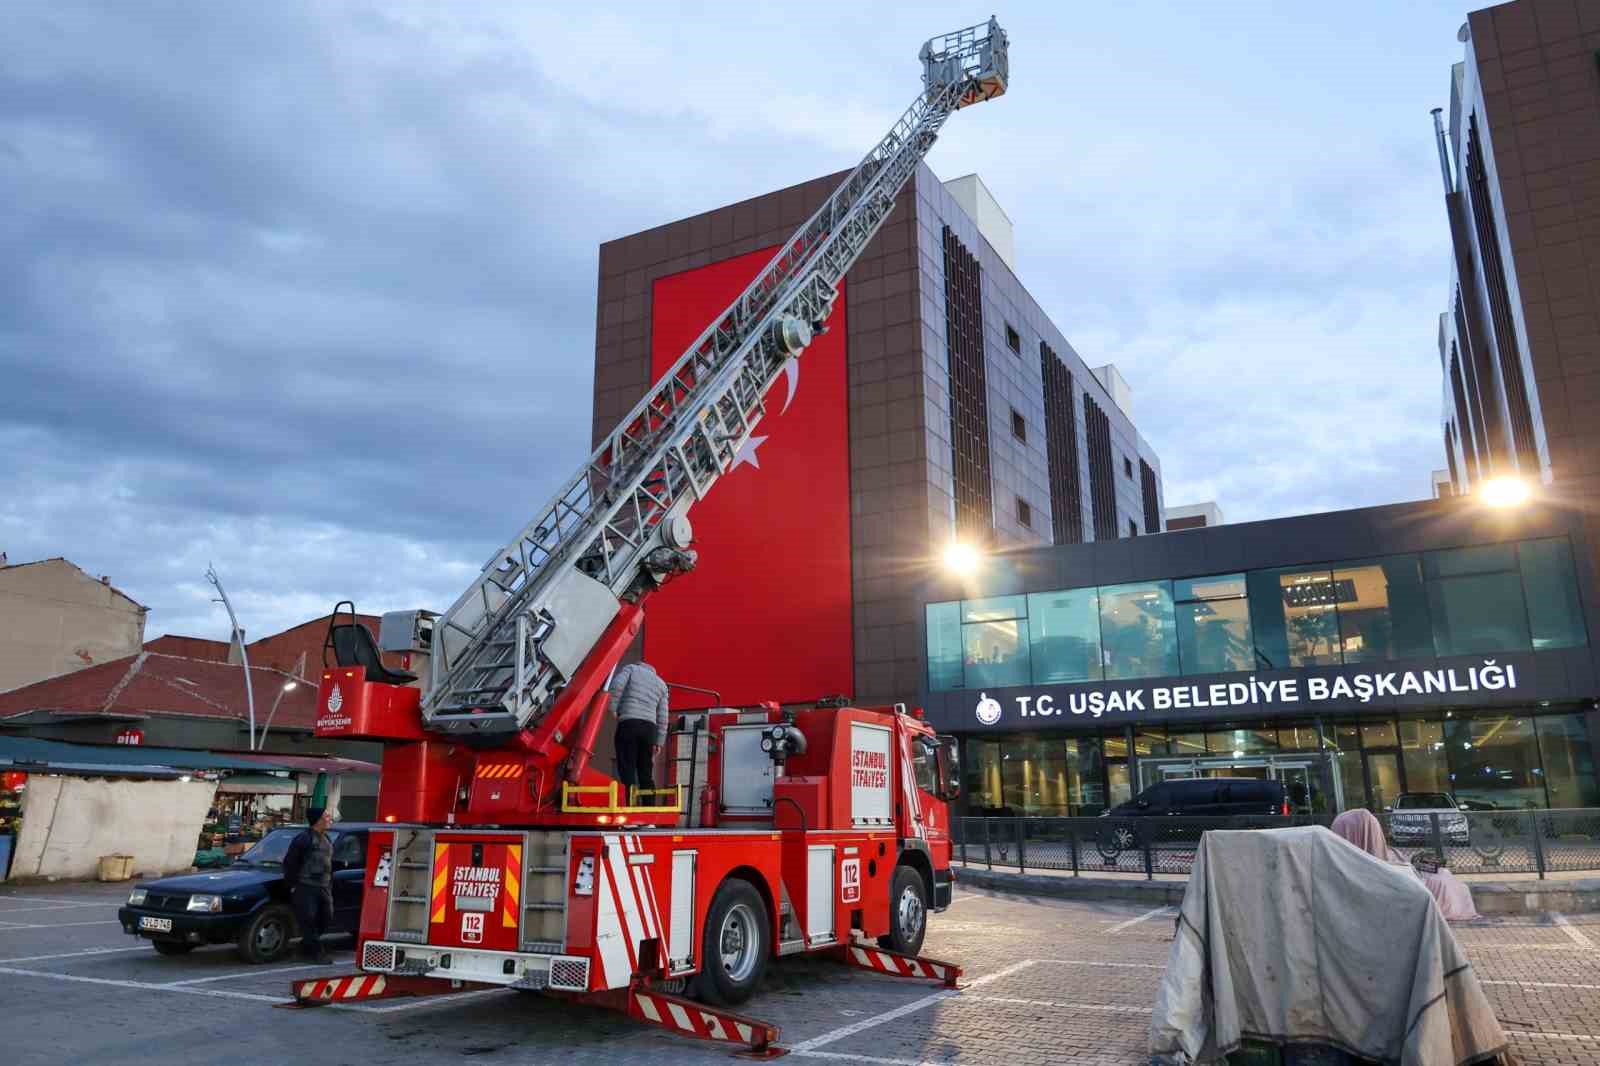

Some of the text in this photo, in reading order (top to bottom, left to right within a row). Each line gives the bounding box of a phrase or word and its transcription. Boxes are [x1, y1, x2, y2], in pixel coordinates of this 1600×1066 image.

[1016, 659, 1517, 718] T.C. UŞAK BELEDİYE BAŞKANLIĞI
[845, 864, 857, 883] 112
[466, 916, 481, 930] 112
